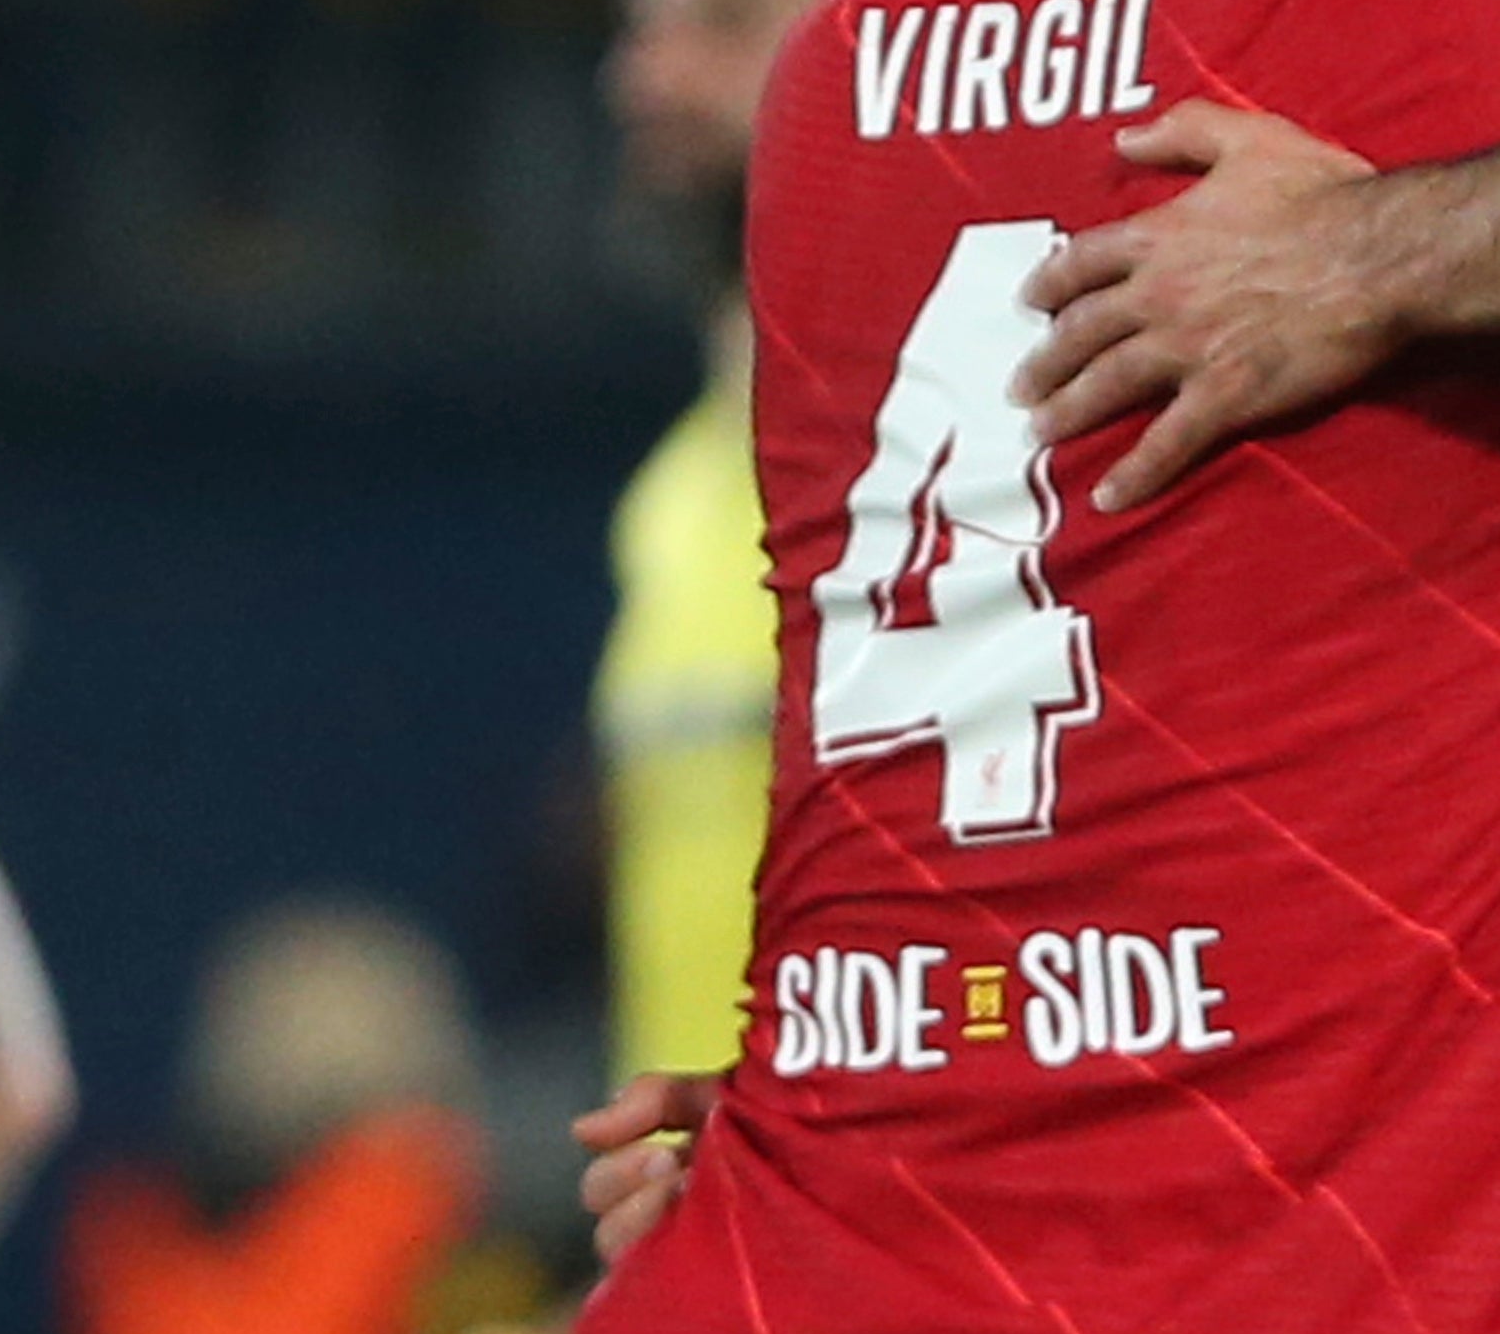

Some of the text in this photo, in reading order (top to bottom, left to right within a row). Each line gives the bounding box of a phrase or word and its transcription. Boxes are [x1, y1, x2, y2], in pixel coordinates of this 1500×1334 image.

[812, 219, 1101, 845] 4
[774, 945, 949, 1077] SIDE
[1018, 926, 1235, 1067] SIDE
